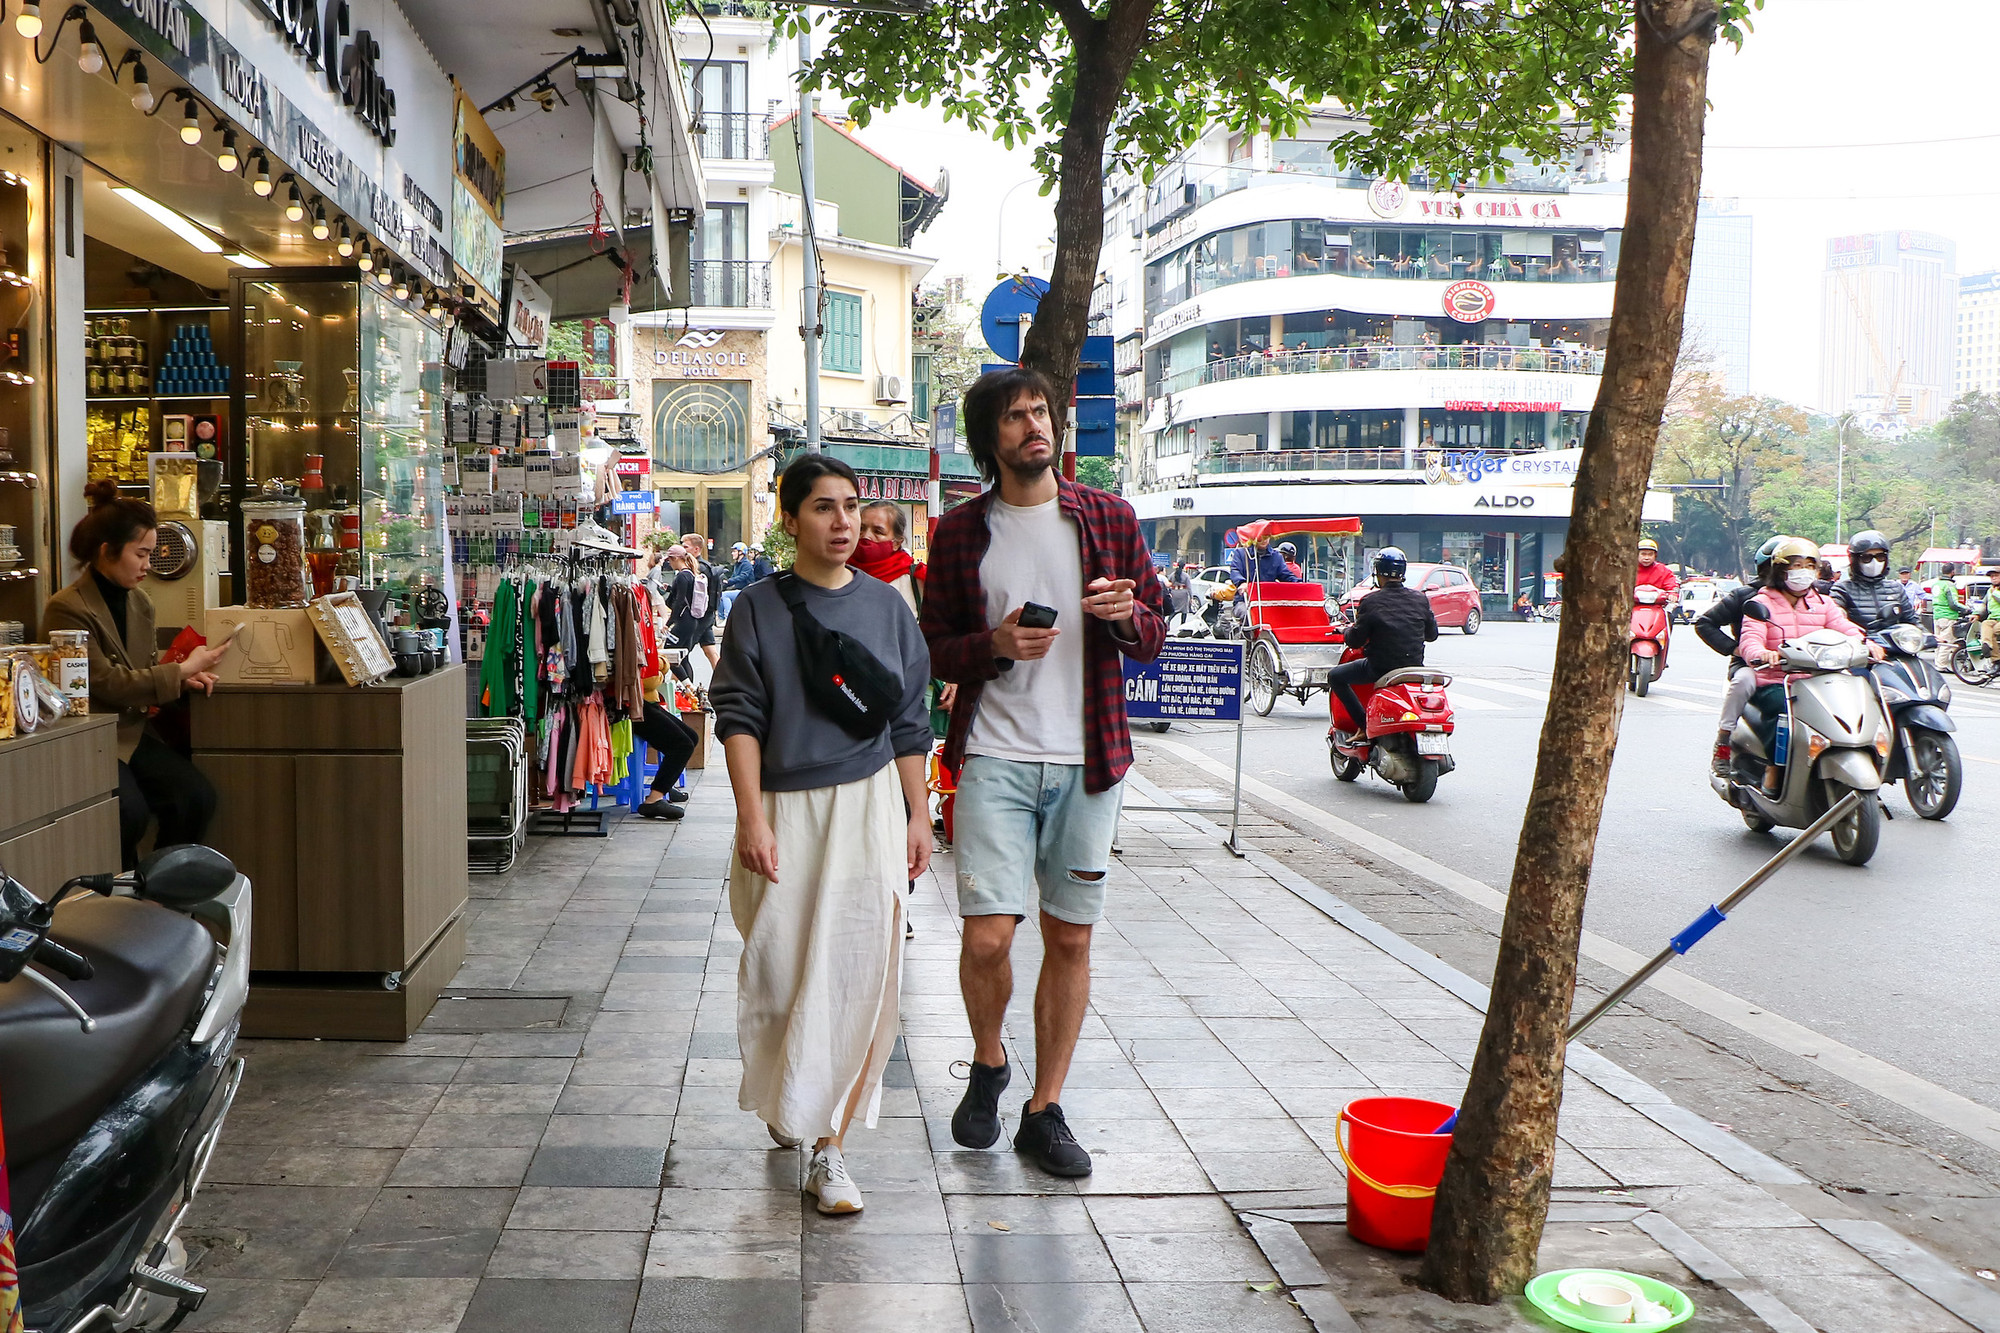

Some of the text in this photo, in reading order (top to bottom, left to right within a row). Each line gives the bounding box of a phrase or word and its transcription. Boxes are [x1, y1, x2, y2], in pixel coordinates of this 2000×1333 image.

[223, 54, 261, 116] MOKA
[1420, 196, 1561, 218] VUA CHẢ CÁ
[1830, 253, 1874, 268] GROUP
[1446, 283, 1494, 300] HIGHLANDS
[1451, 310, 1488, 321] COFFEE
[656, 351, 747, 366] DELASOIE
[683, 367, 719, 376] HOTEL
[1445, 400, 1562, 413] COFFEE & RESTAURANT
[614, 463, 639, 472] ATCH
[1446, 451, 1579, 482] Tiger CRYSTAL
[616, 500, 651, 510] HÀNG ĐÀO
[1173, 497, 1194, 509] ALDO
[1474, 496, 1534, 507] ALDO
[1170, 663, 1177, 671] XE
[1188, 664, 1196, 672] XE
[1125, 671, 1158, 702] CẤM
